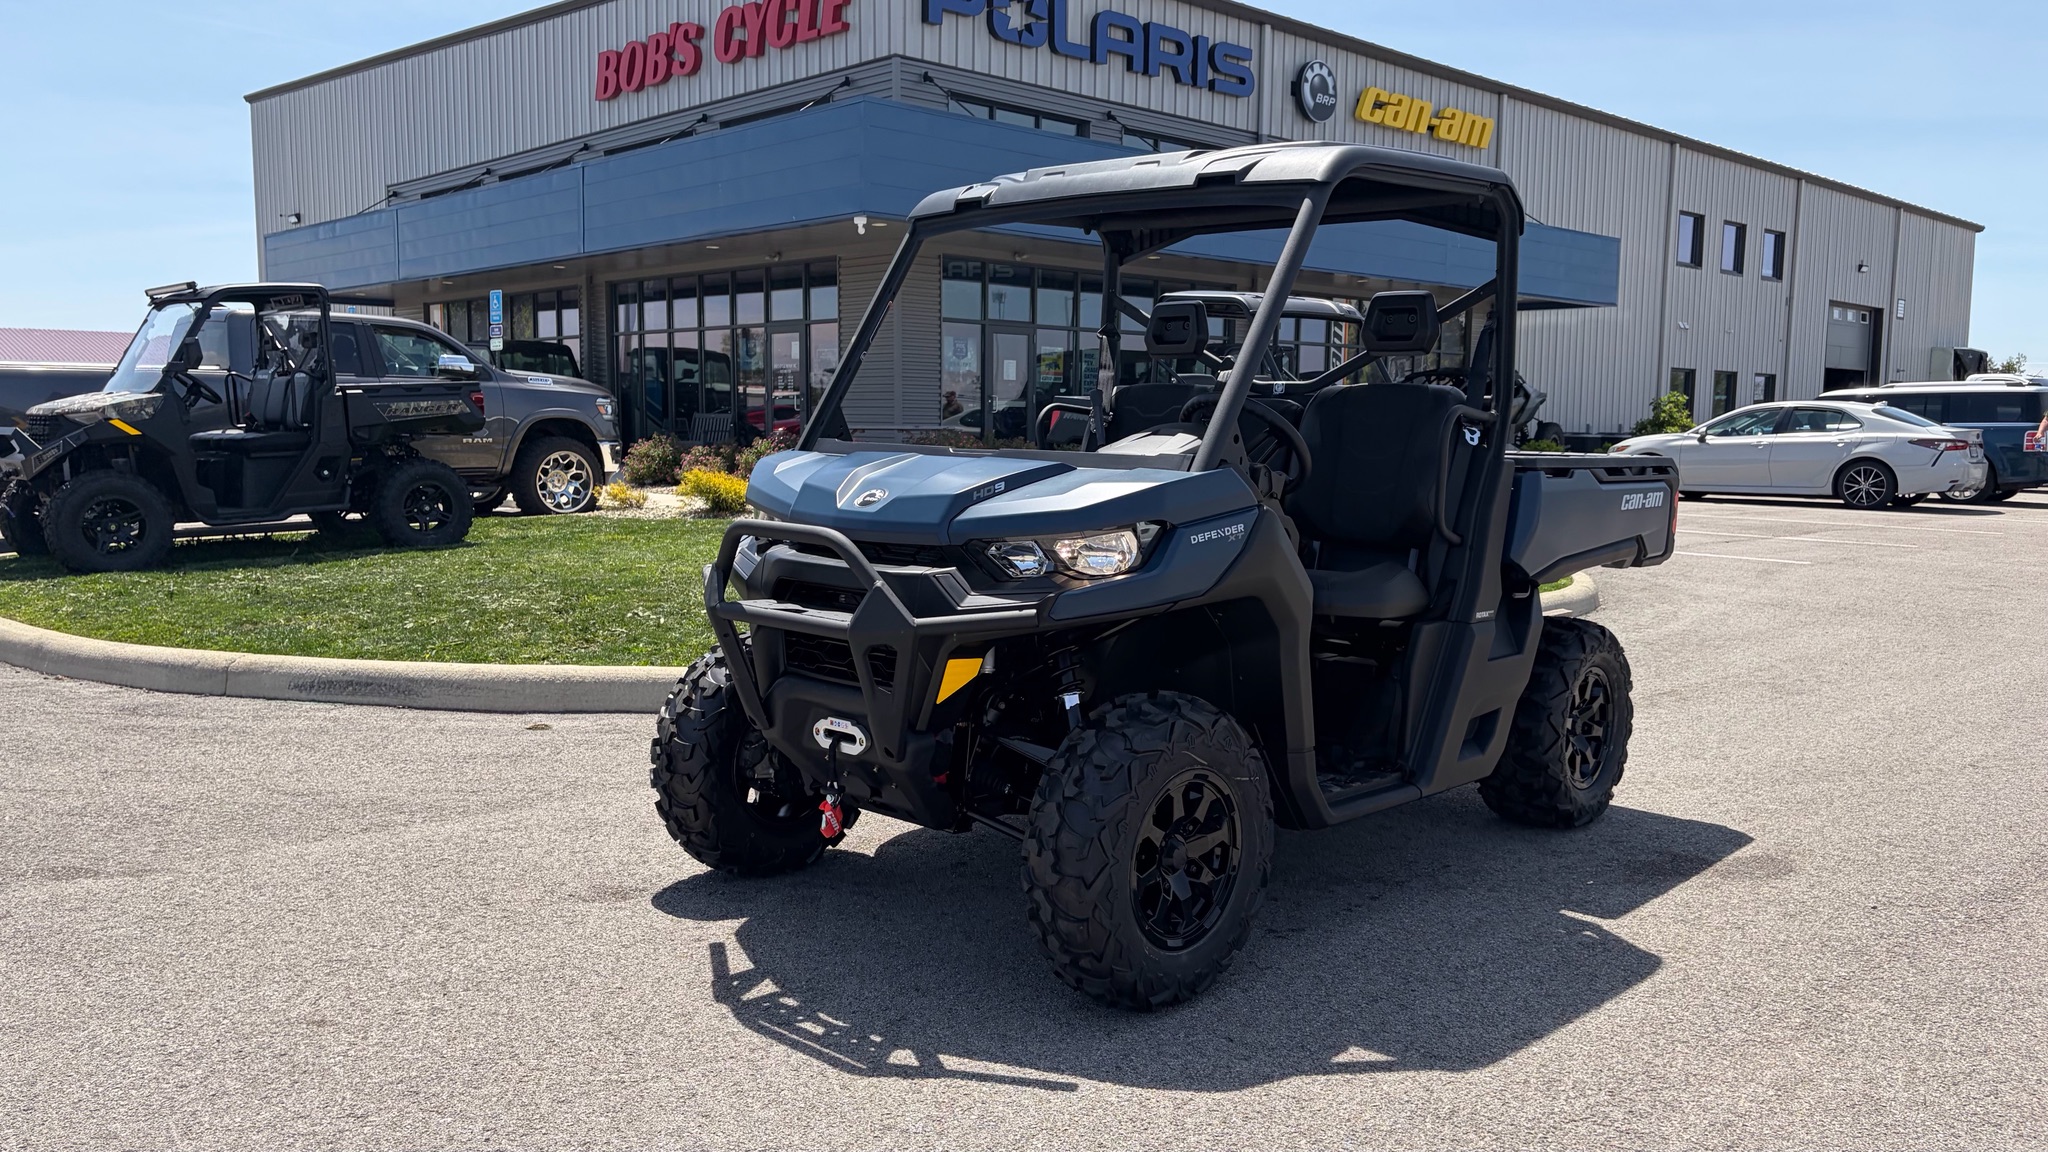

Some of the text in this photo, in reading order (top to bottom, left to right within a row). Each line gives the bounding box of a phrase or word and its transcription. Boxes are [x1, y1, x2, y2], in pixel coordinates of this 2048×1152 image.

[595, 0, 851, 101] BOB'S CYCLE
[1315, 93, 1336, 107] BRP
[1355, 86, 1495, 149] can-am
[386, 403, 463, 416] RANGER
[973, 481, 1005, 501] HD9
[1190, 523, 1244, 544] DEFENDER
[1228, 532, 1245, 542] XT
